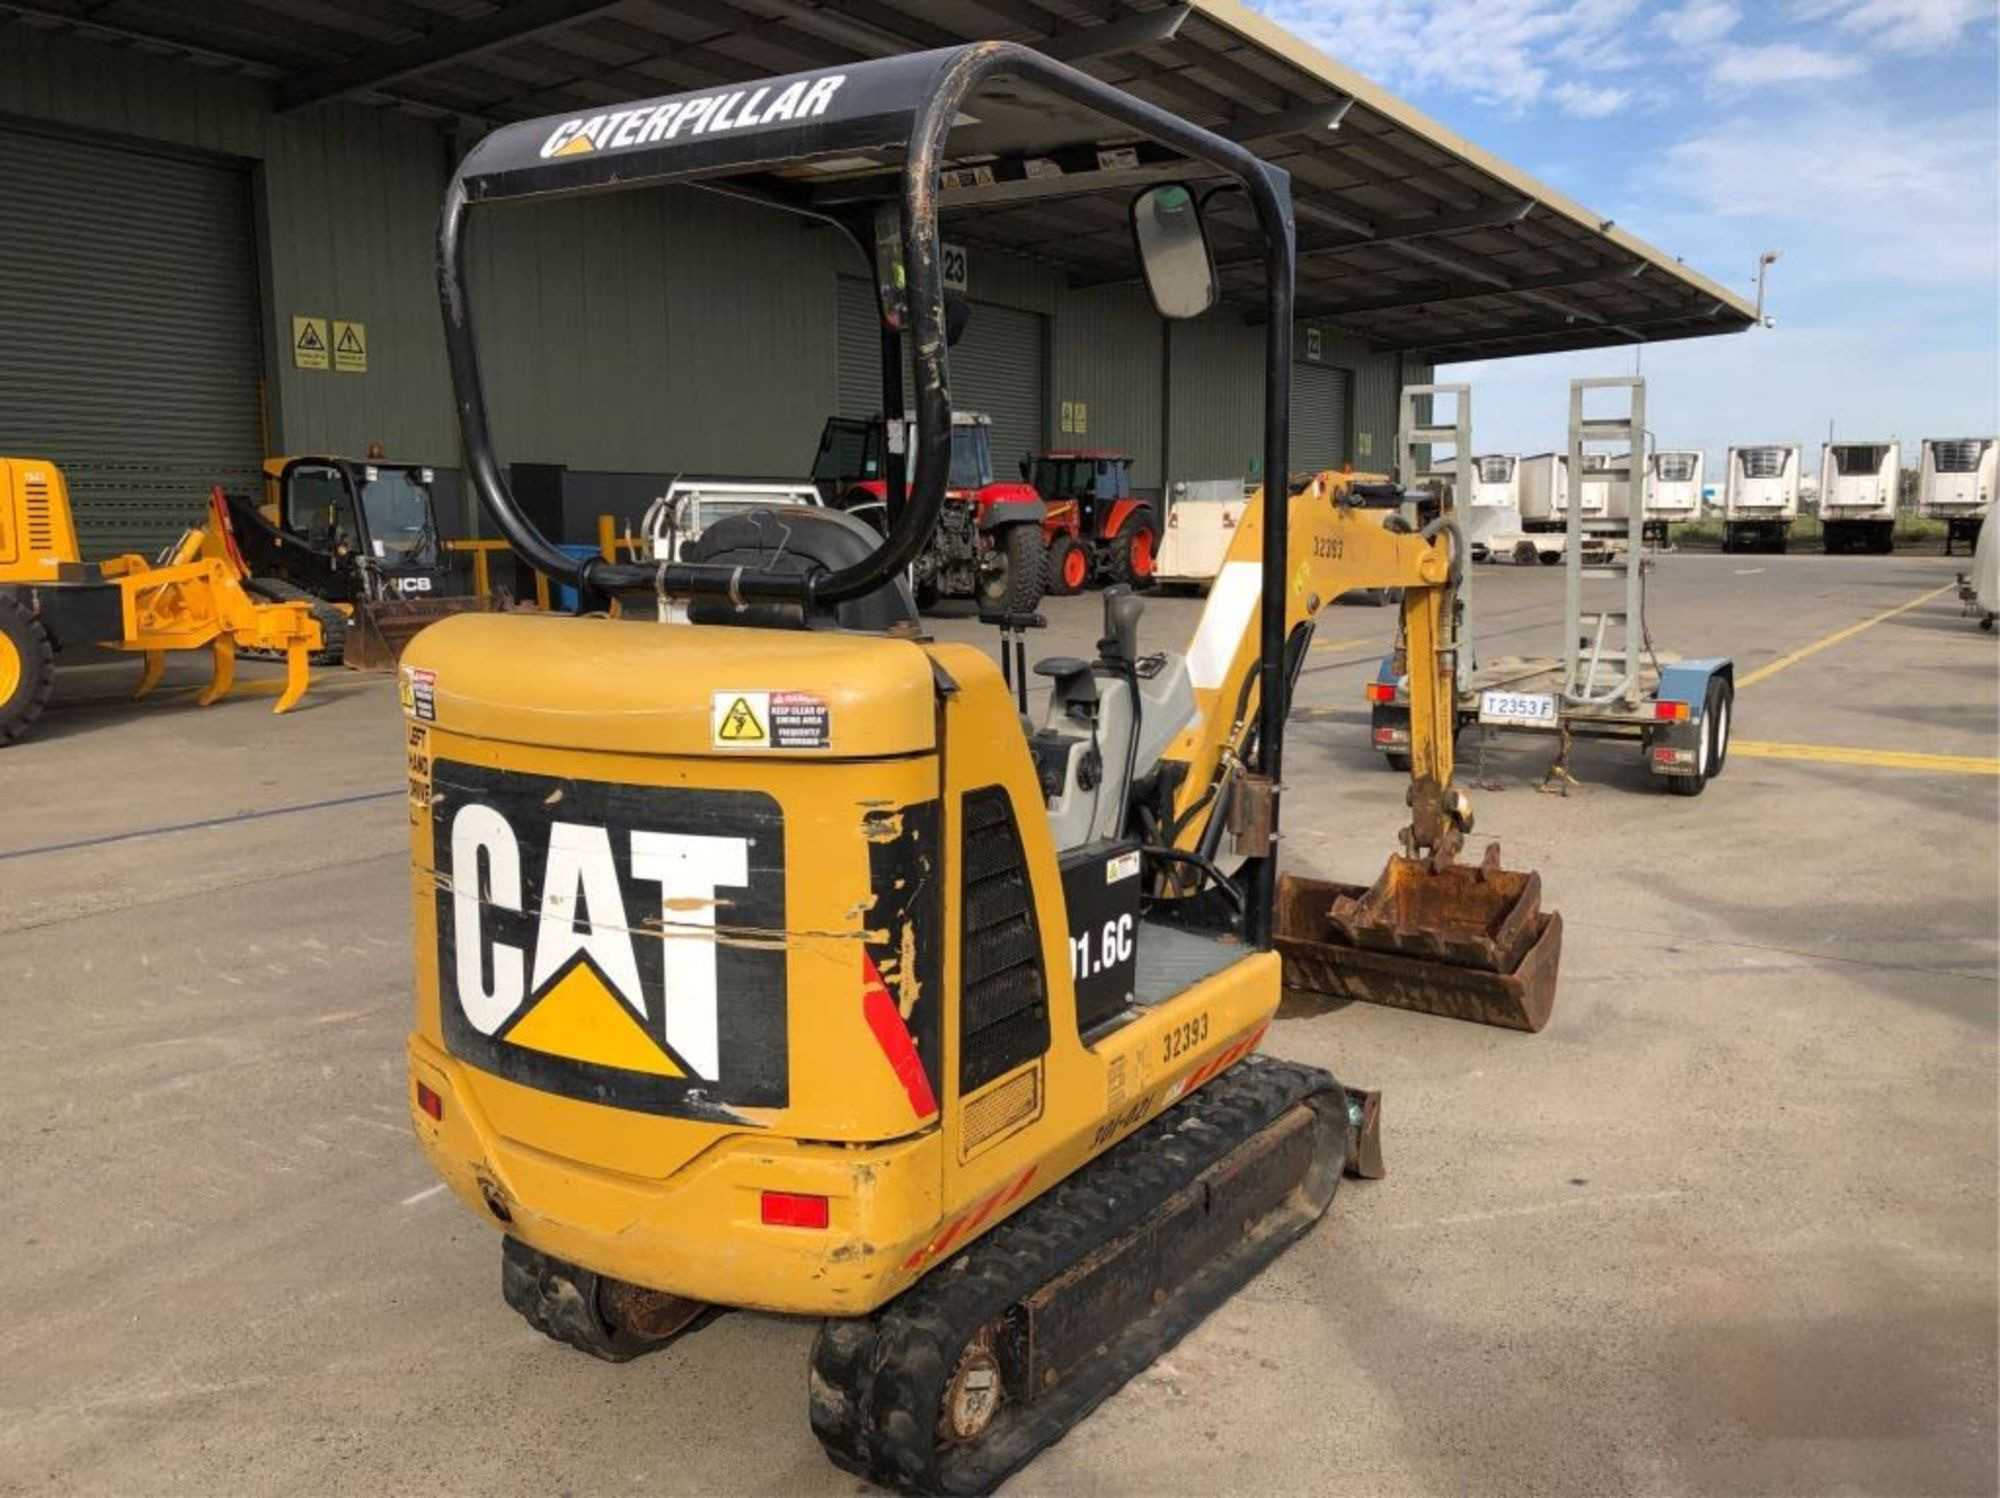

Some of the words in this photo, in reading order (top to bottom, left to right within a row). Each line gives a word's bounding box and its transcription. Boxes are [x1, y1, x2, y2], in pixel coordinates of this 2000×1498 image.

[540, 75, 846, 158] CATERPILLAR
[944, 251, 965, 283] 23
[452, 804, 749, 1081] CAT
[1163, 1012, 1209, 1063] 32393
